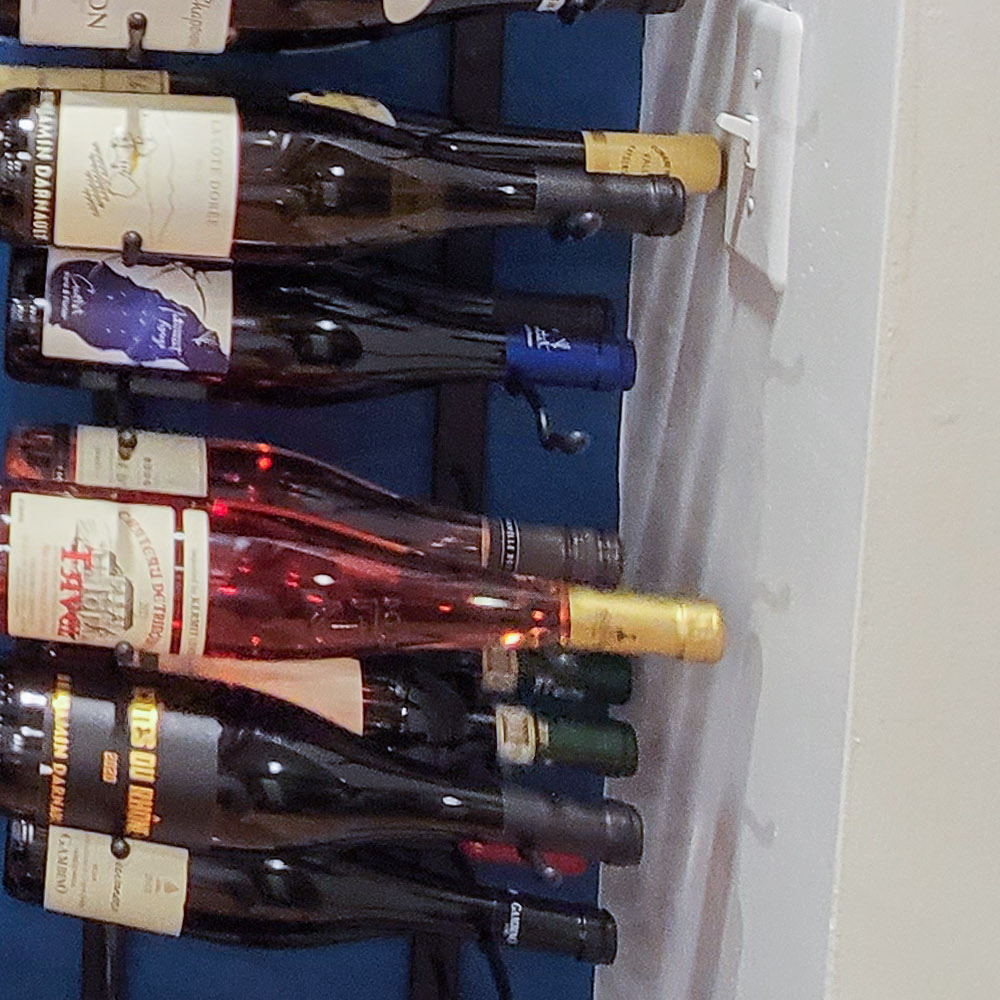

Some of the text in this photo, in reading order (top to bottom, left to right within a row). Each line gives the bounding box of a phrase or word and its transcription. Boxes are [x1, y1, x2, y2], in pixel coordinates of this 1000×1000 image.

[207, 136, 222, 175] CÔTE
[30, 164, 51, 242] DARNAULT
[205, 179, 222, 228] DORÉE
[188, 596, 200, 637] KERMIT
[128, 750, 157, 784] DU
